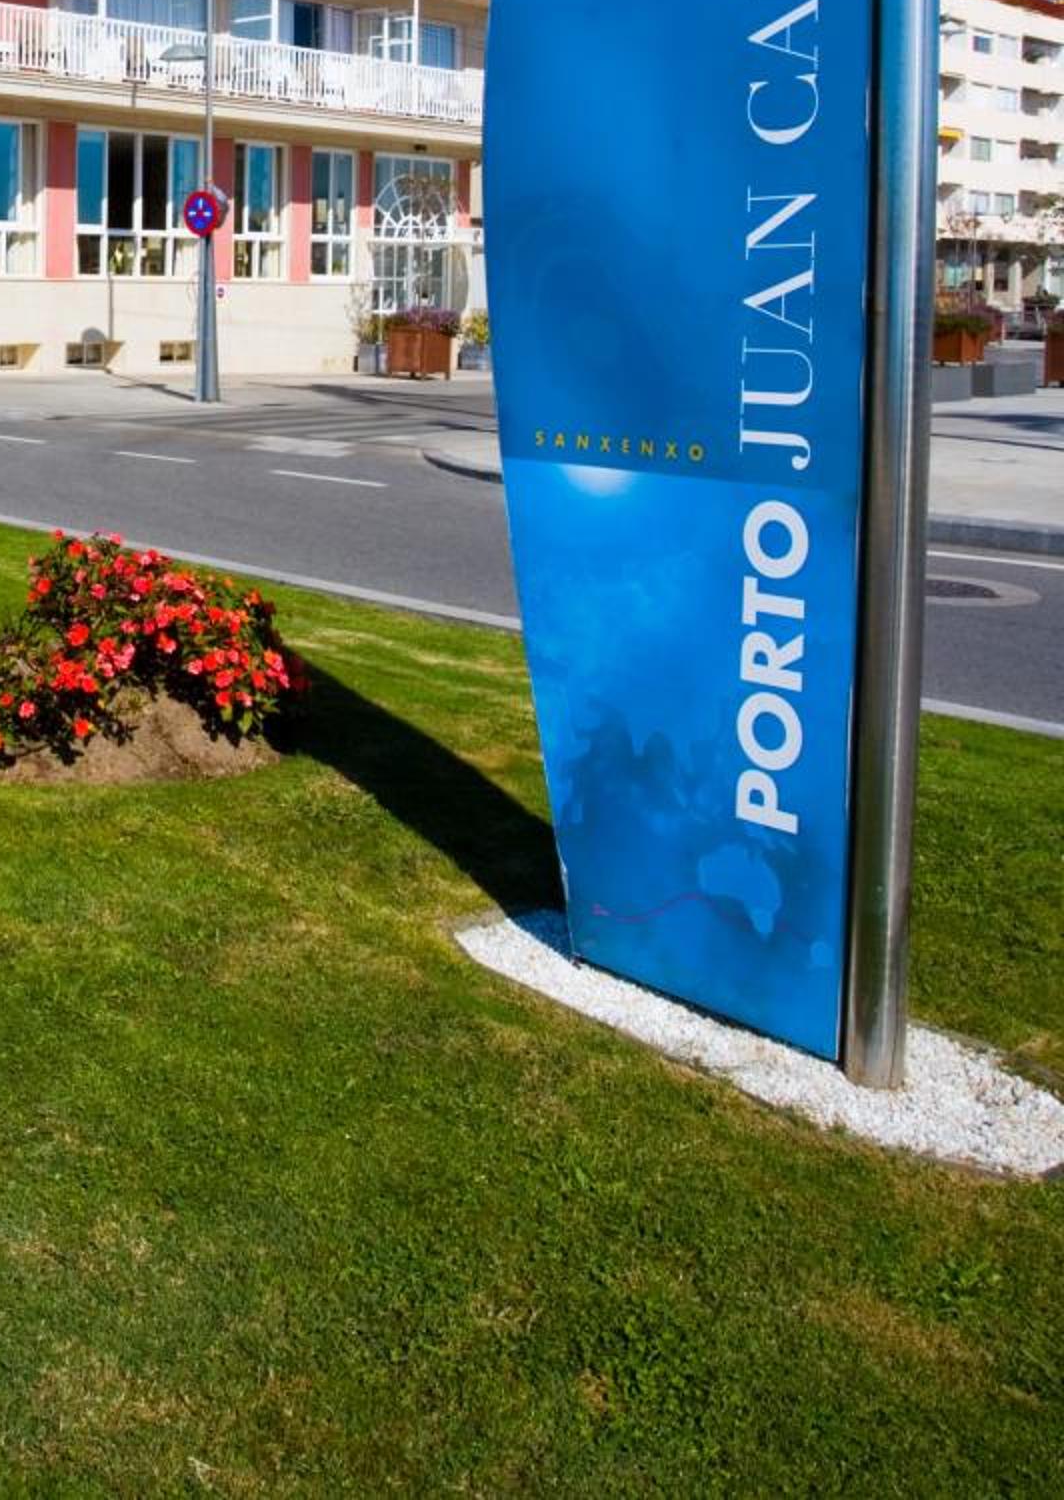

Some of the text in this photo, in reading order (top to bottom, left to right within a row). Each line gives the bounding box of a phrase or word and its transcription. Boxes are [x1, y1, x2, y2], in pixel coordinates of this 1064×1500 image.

[535, 430, 704, 463] SANXENXO
[739, 186, 818, 471] JUAN
[735, 499, 810, 836] PORTO
